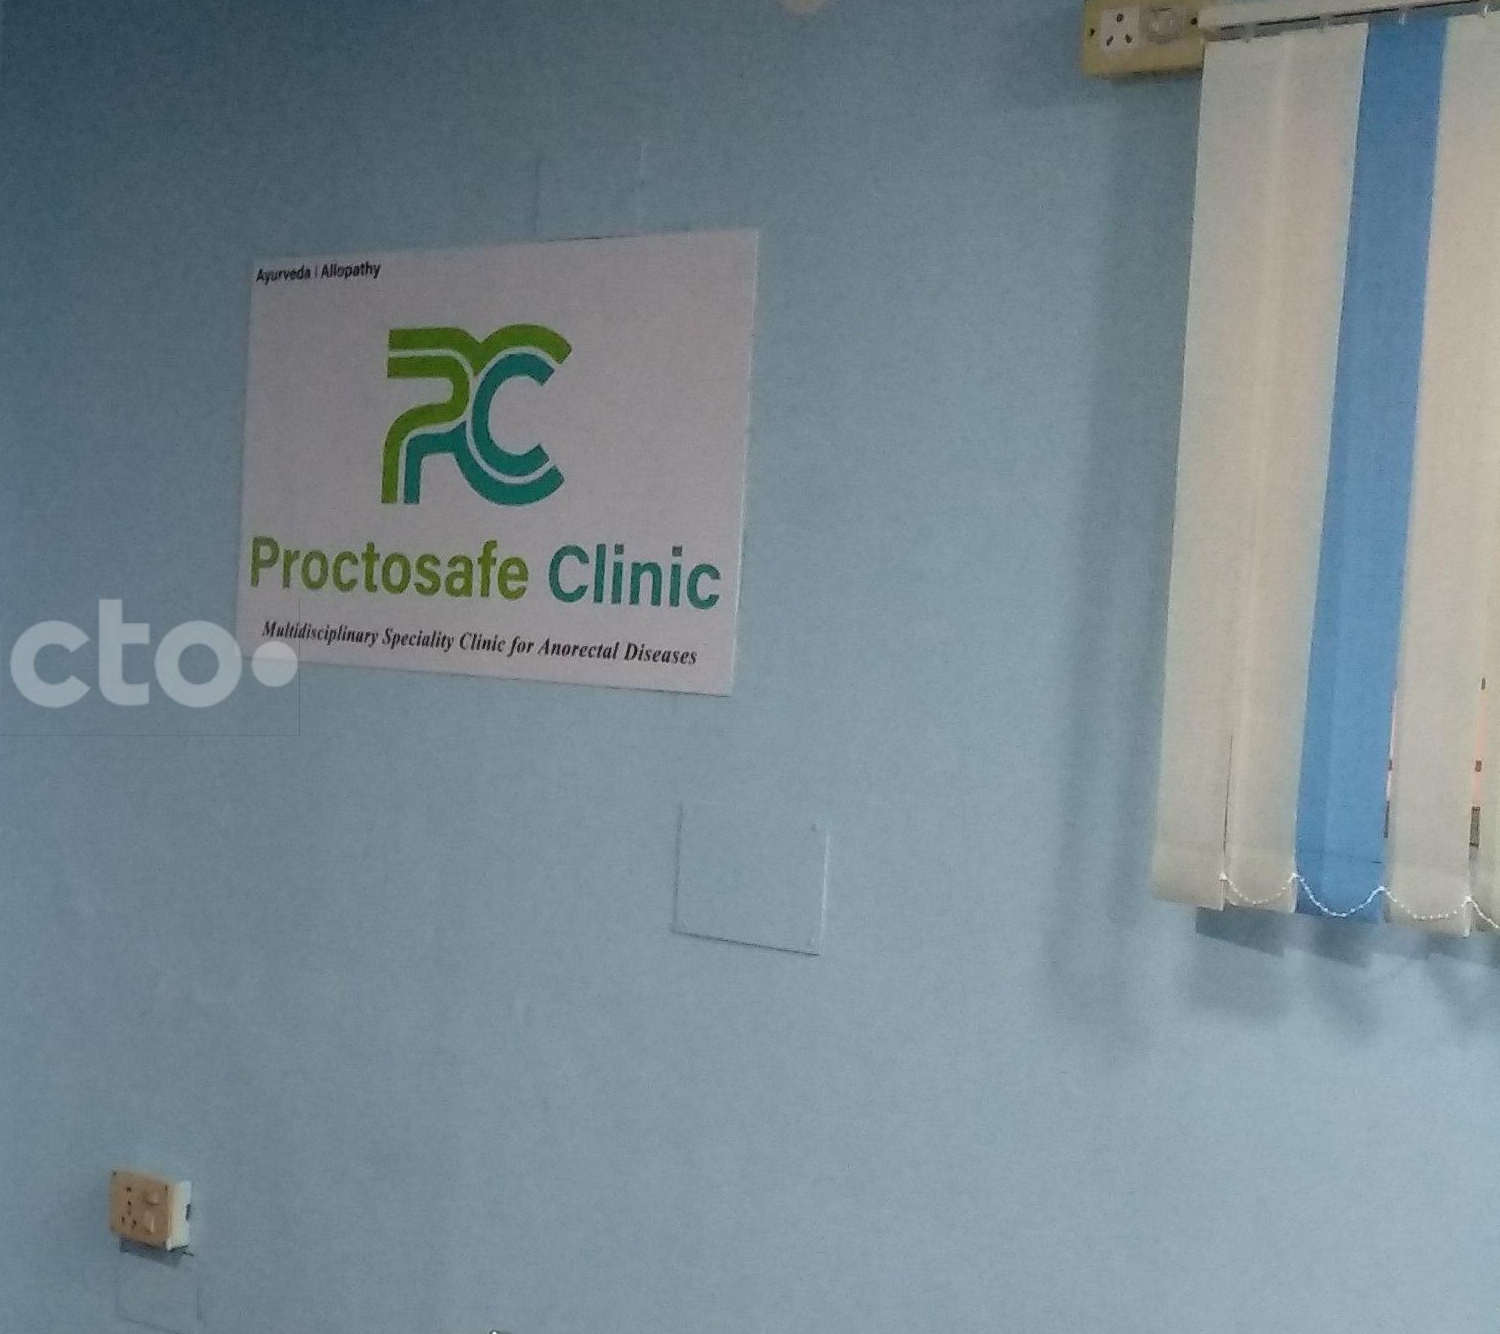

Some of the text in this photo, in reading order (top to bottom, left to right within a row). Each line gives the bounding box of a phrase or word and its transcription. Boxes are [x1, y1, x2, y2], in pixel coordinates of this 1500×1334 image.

[256, 265, 311, 285] Ayurveda
[322, 260, 381, 279] Allopathy
[250, 536, 721, 609] Proctosafe Clinic
[262, 621, 697, 665] Multidisciplinary Speciality Clinic for Anorectal Diseases
